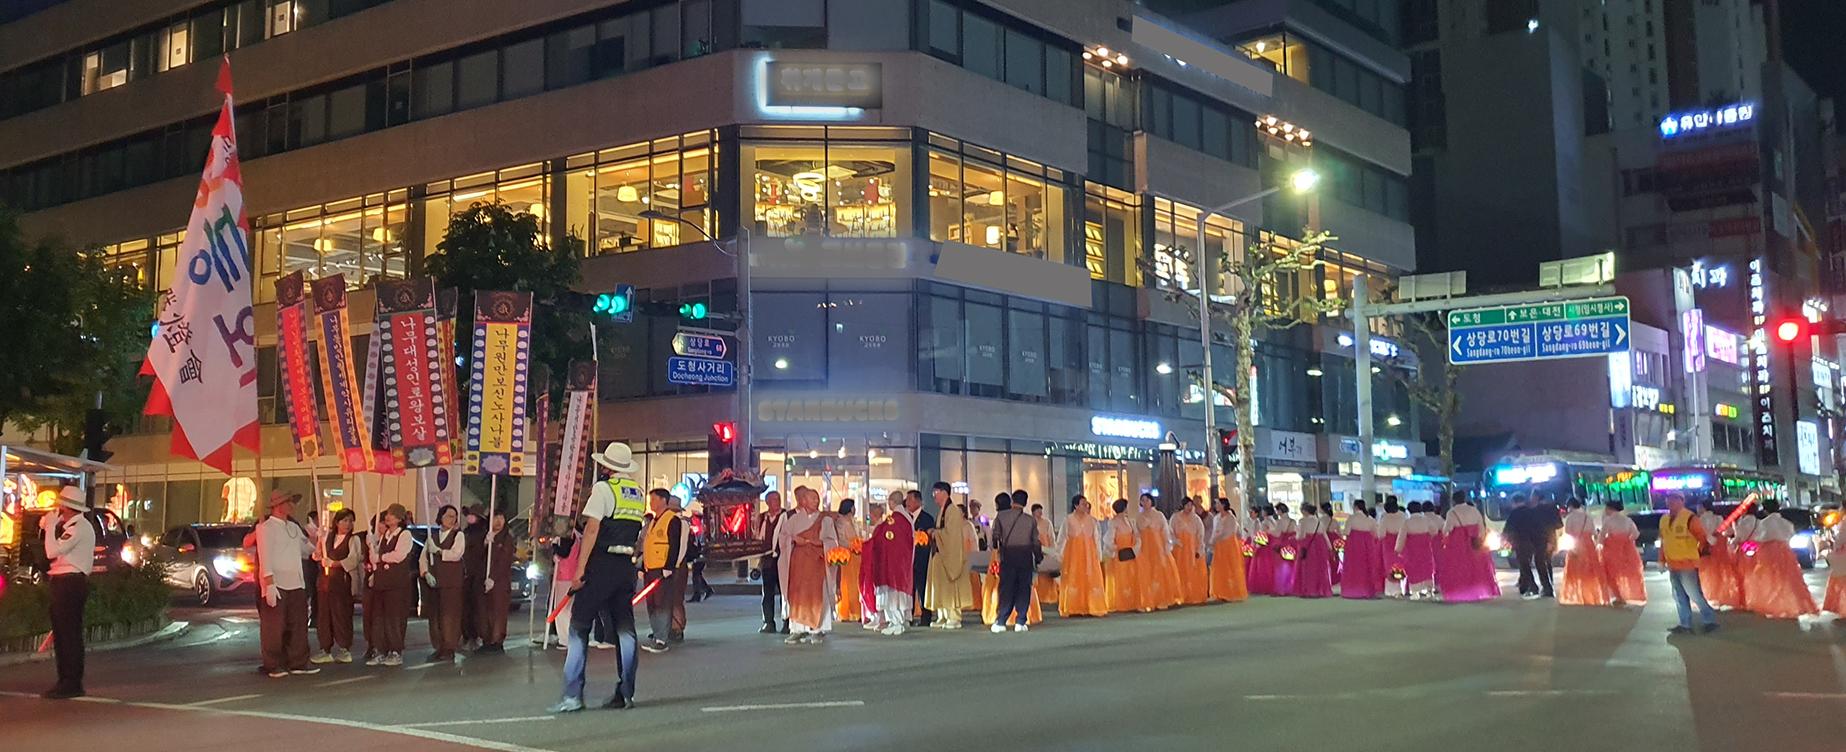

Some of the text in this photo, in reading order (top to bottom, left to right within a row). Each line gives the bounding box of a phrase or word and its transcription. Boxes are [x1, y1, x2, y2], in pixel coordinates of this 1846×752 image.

[1463, 312, 1480, 324] 도청
[1467, 327, 1530, 347] 상당로70번길
[1542, 321, 1610, 342] 상당로69번길
[689, 337, 710, 348] 상당로
[767, 335, 795, 343] KYOBO
[859, 335, 887, 343] KYOBO
[1467, 347, 1500, 358] Sangdang-ro
[1542, 342, 1578, 353] Sangdang-ro
[677, 360, 725, 374] 도청사거리
[400, 316, 427, 441] 나무대성인로왕보살
[672, 371, 729, 383] Docheong Junction
[489, 327, 510, 449] 나무원만보신노사나불
